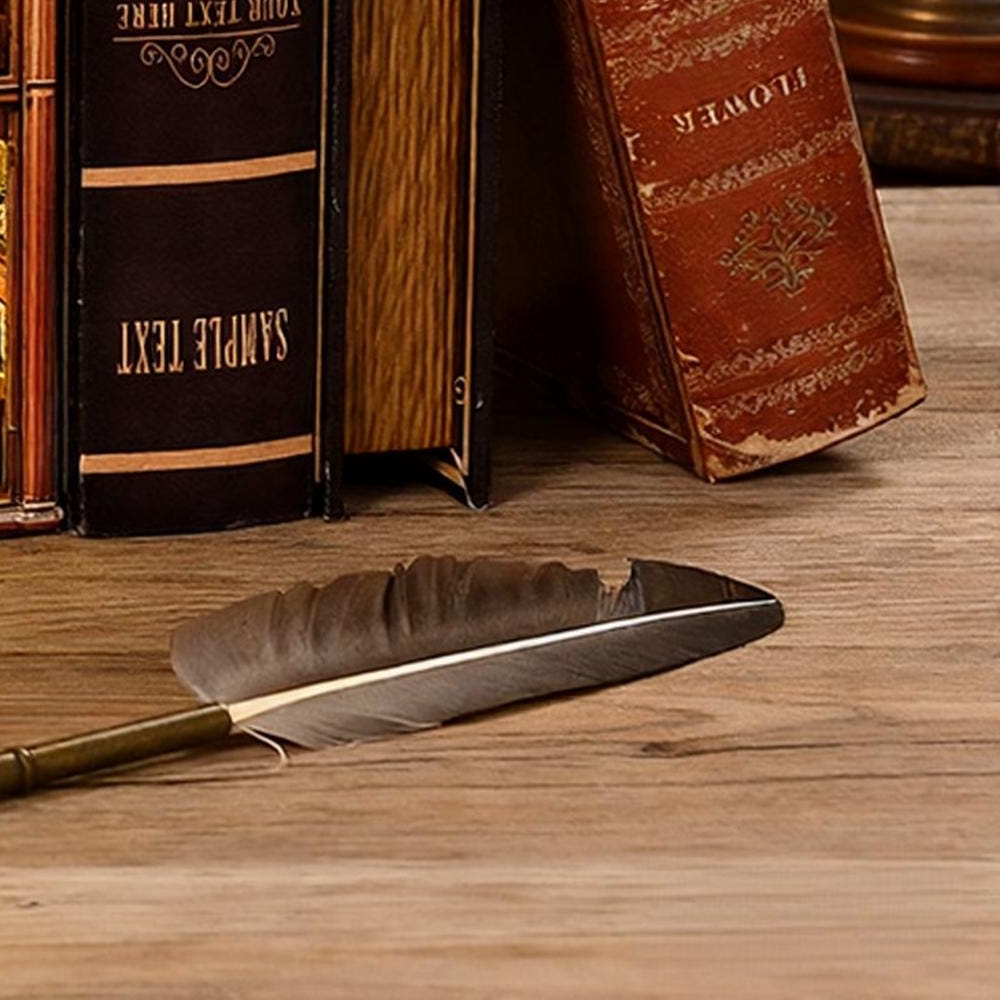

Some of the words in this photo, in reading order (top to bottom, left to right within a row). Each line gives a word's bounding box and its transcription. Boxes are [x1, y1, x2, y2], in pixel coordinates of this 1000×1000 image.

[117, 3, 175, 29] HERE
[186, 0, 240, 27] TEXT
[672, 66, 808, 134] FLOWER
[118, 320, 184, 375] TEXT
[194, 308, 288, 370] SAMPLE
